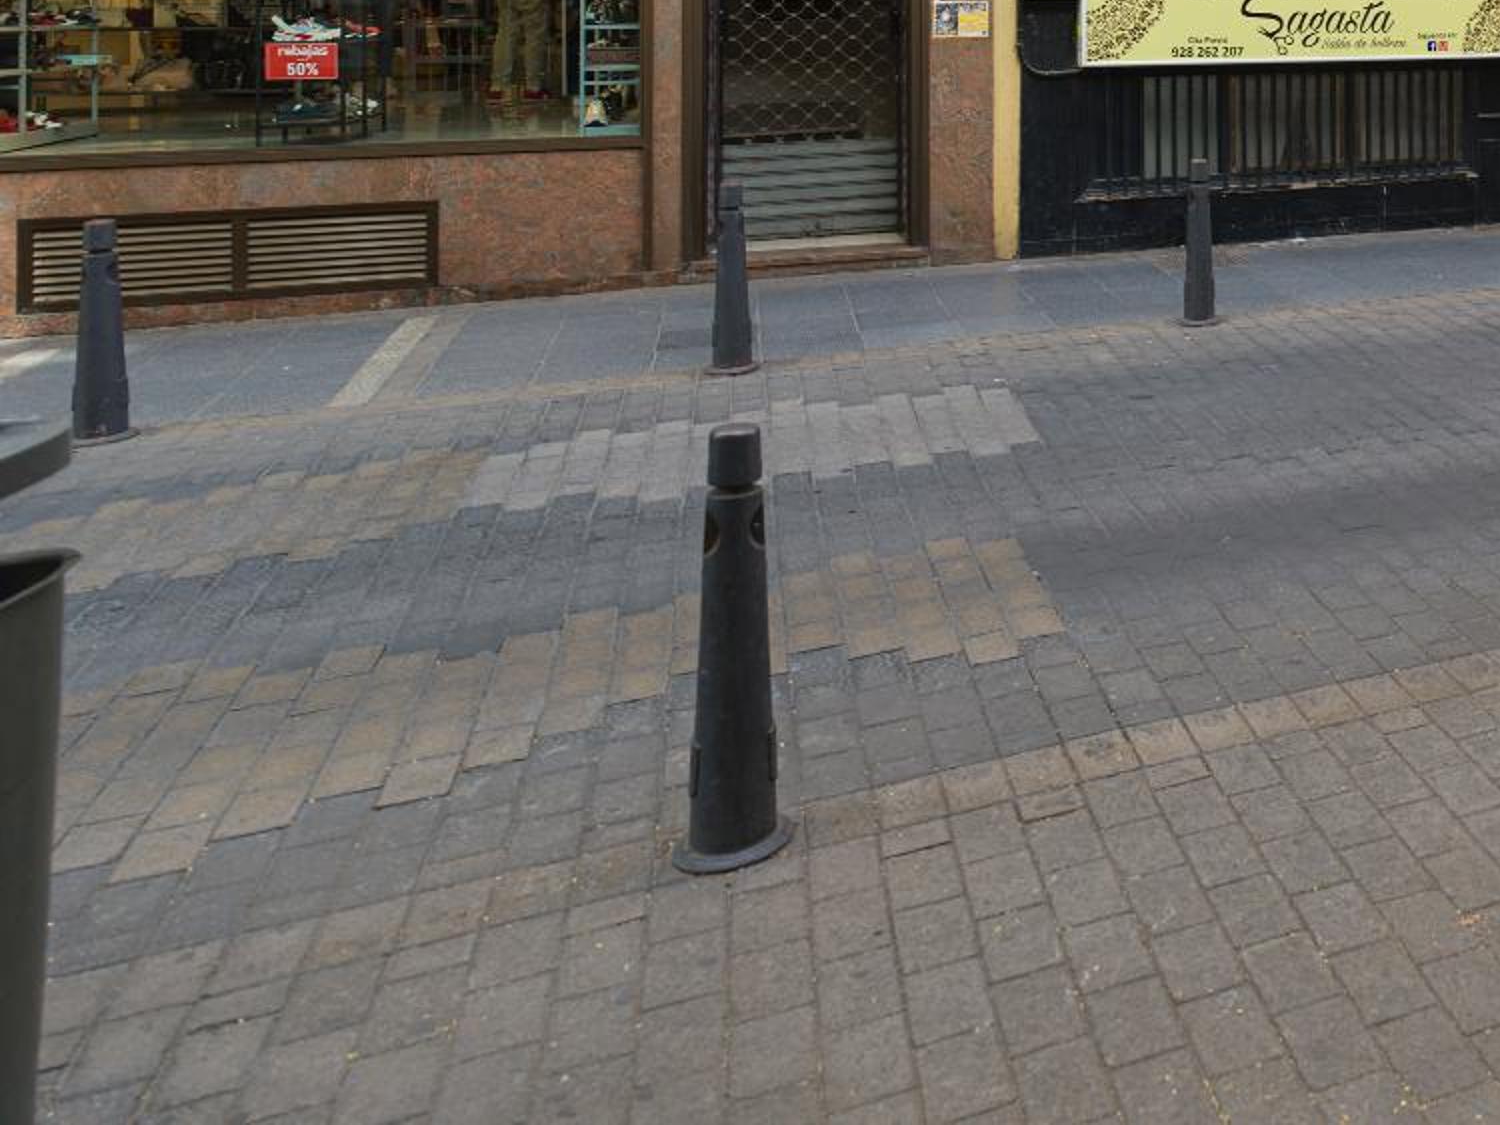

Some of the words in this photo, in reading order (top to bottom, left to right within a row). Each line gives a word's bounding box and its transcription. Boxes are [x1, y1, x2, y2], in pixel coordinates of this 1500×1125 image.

[277, 44, 329, 60] rebajas
[1171, 46, 1195, 59] 928
[1197, 46, 1220, 59] 262
[1223, 46, 1245, 59] 207
[287, 62, 320, 76] 50%
